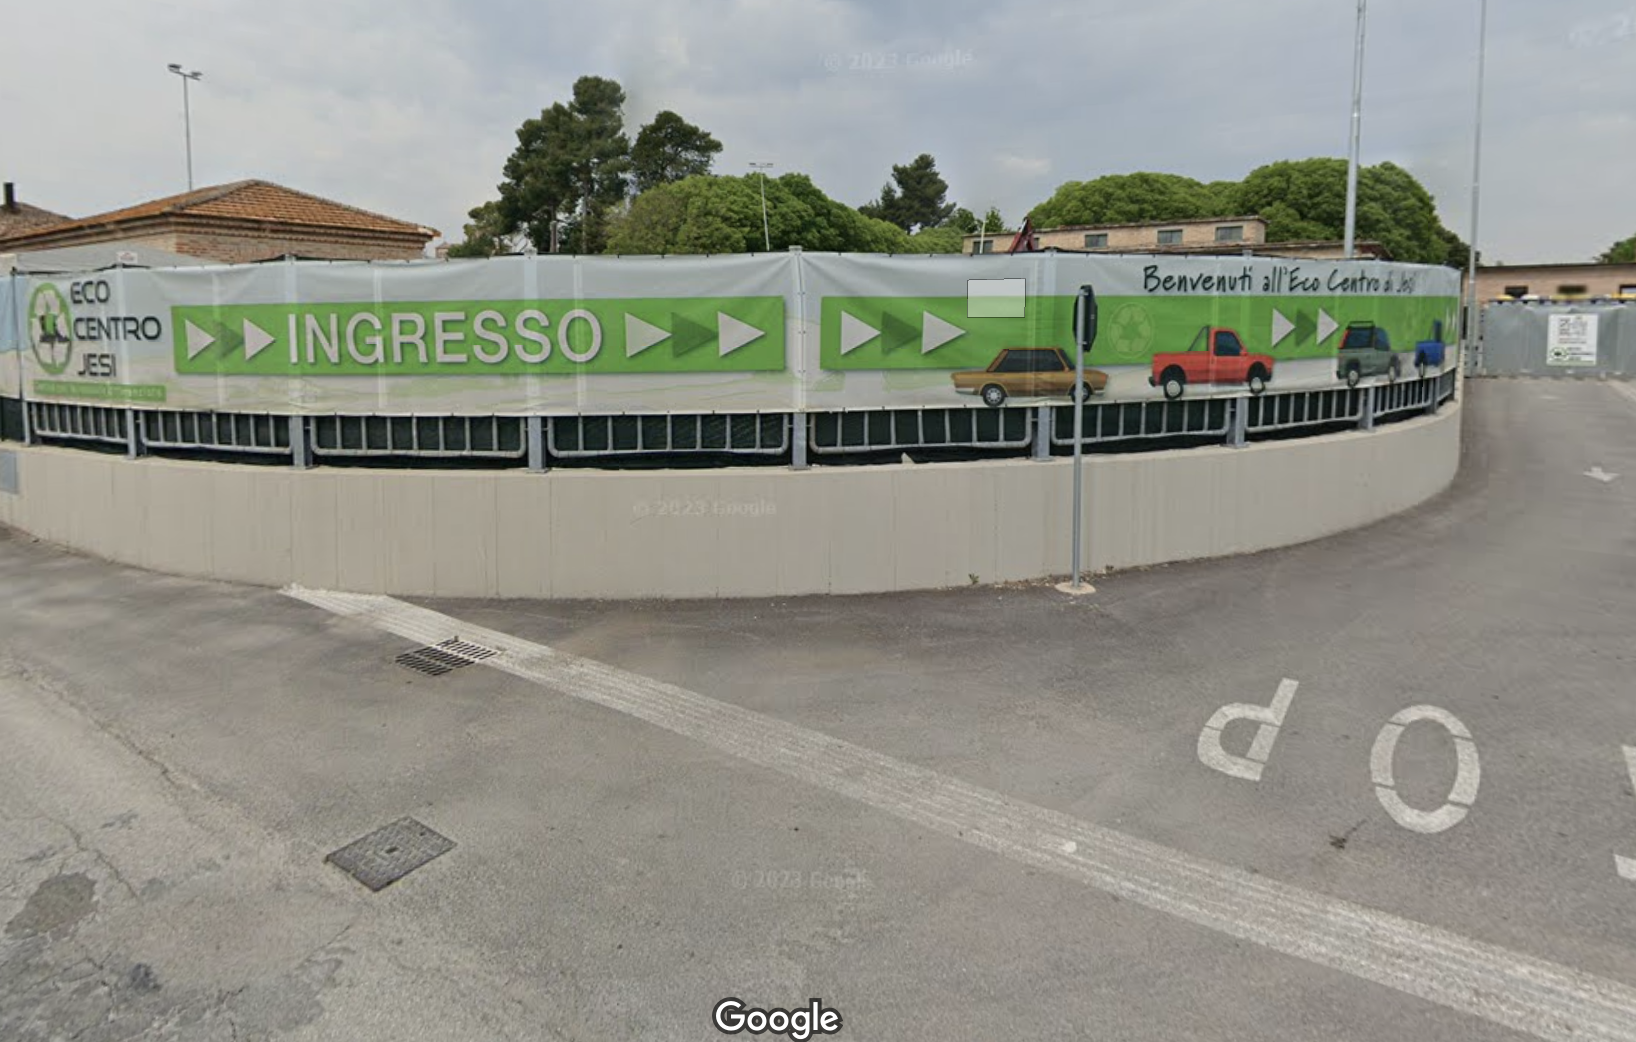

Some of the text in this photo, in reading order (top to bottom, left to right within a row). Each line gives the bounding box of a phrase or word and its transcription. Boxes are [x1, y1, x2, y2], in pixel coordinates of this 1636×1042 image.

[1143, 265, 1253, 293] Benvenuti
[1327, 268, 1380, 293] Centro
[70, 280, 110, 304] ECO
[73, 316, 162, 341] CENTRO
[287, 308, 603, 365] INGRESSO
[78, 353, 117, 377] JESI
